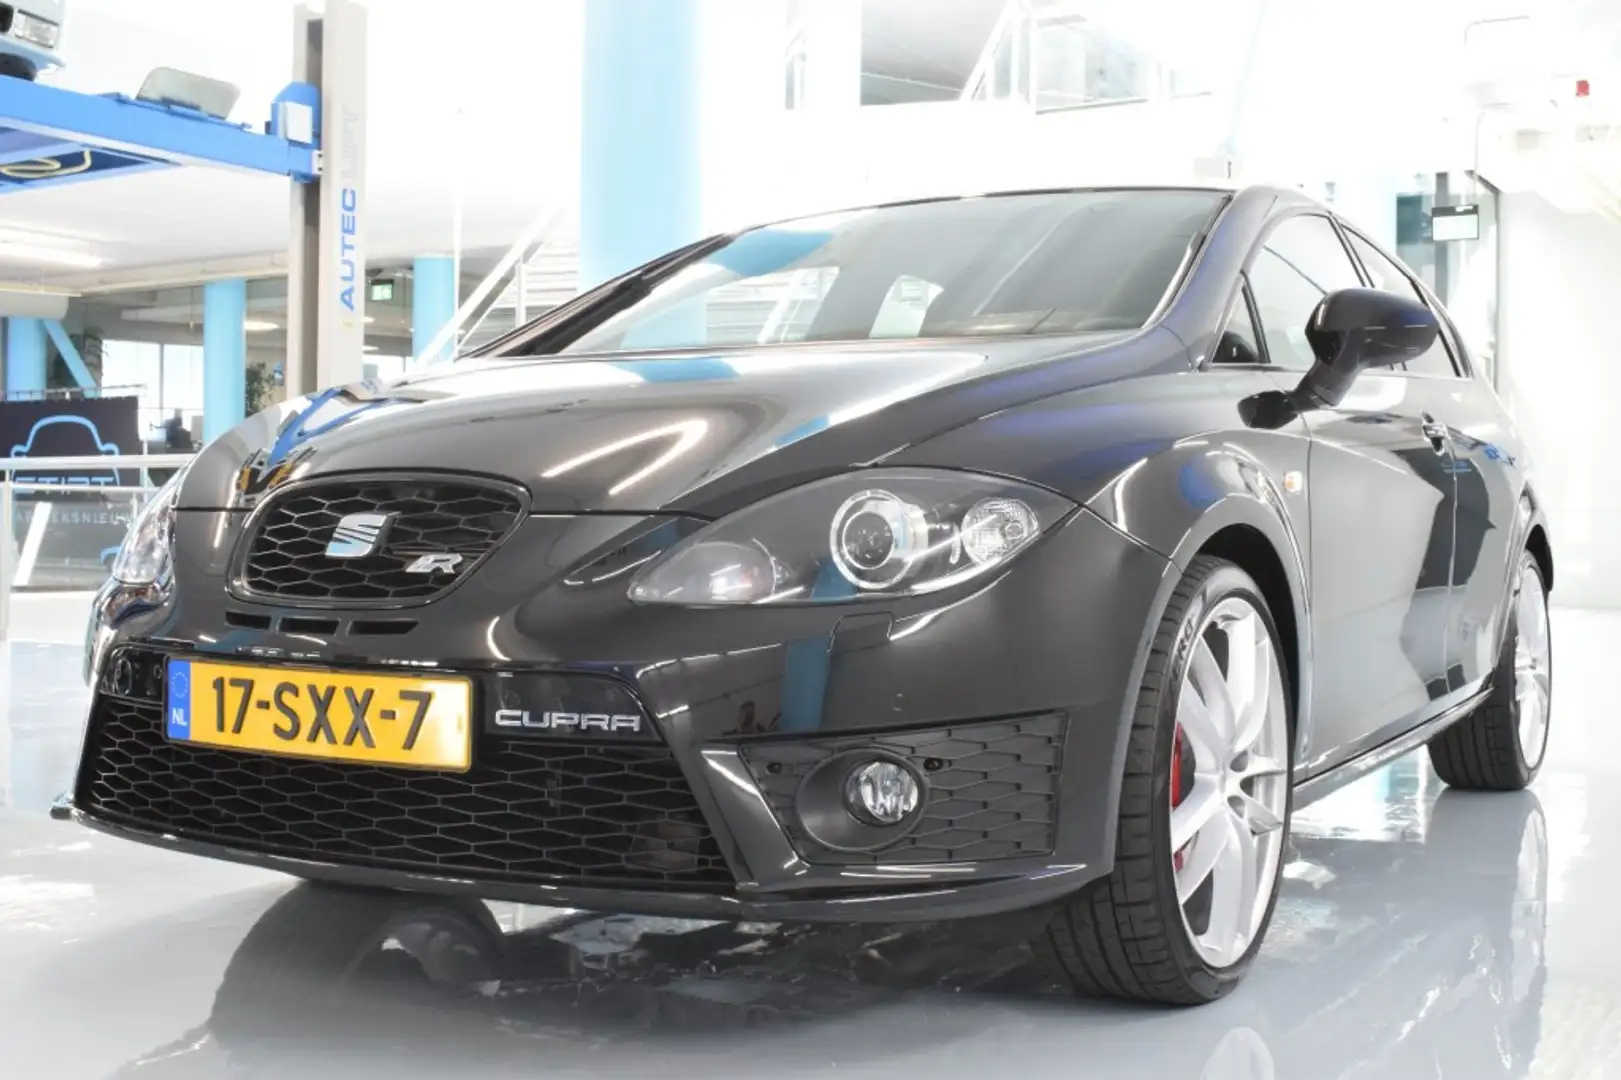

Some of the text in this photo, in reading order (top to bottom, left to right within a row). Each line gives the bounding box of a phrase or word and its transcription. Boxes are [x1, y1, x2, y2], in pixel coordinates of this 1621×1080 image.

[340, 188, 356, 312] AUTEC
[172, 707, 188, 726] NL
[212, 676, 434, 750] 17-SXX-7
[495, 709, 640, 732] CUPRA
